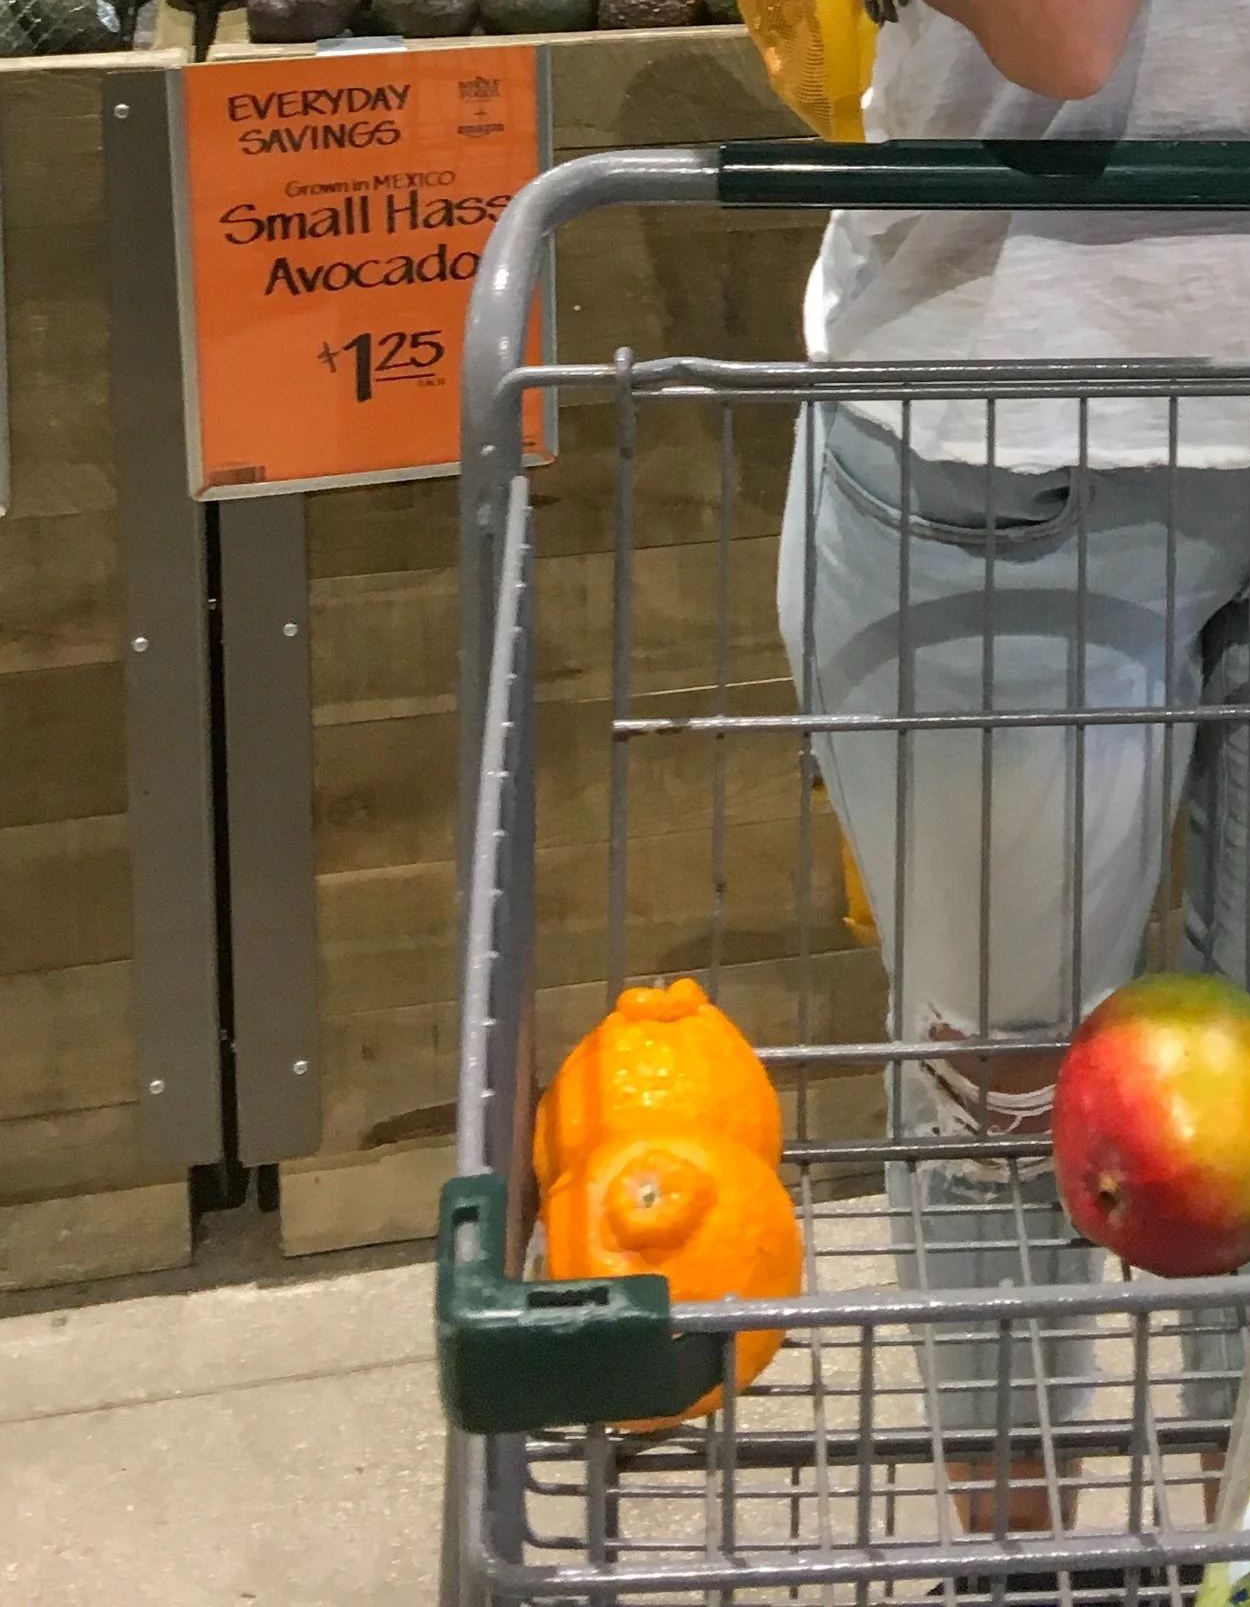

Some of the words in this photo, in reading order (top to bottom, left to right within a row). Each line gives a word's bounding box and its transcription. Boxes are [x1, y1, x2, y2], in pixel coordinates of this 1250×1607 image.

[228, 84, 410, 122] EVERYDAY
[238, 120, 401, 155] SAVINGS
[285, 180, 348, 197] Grown
[352, 177, 370, 192] in
[373, 170, 455, 191] MEXICO
[219, 195, 369, 245] Small
[386, 190, 513, 234] Hass
[264, 244, 480, 296] Avocado
